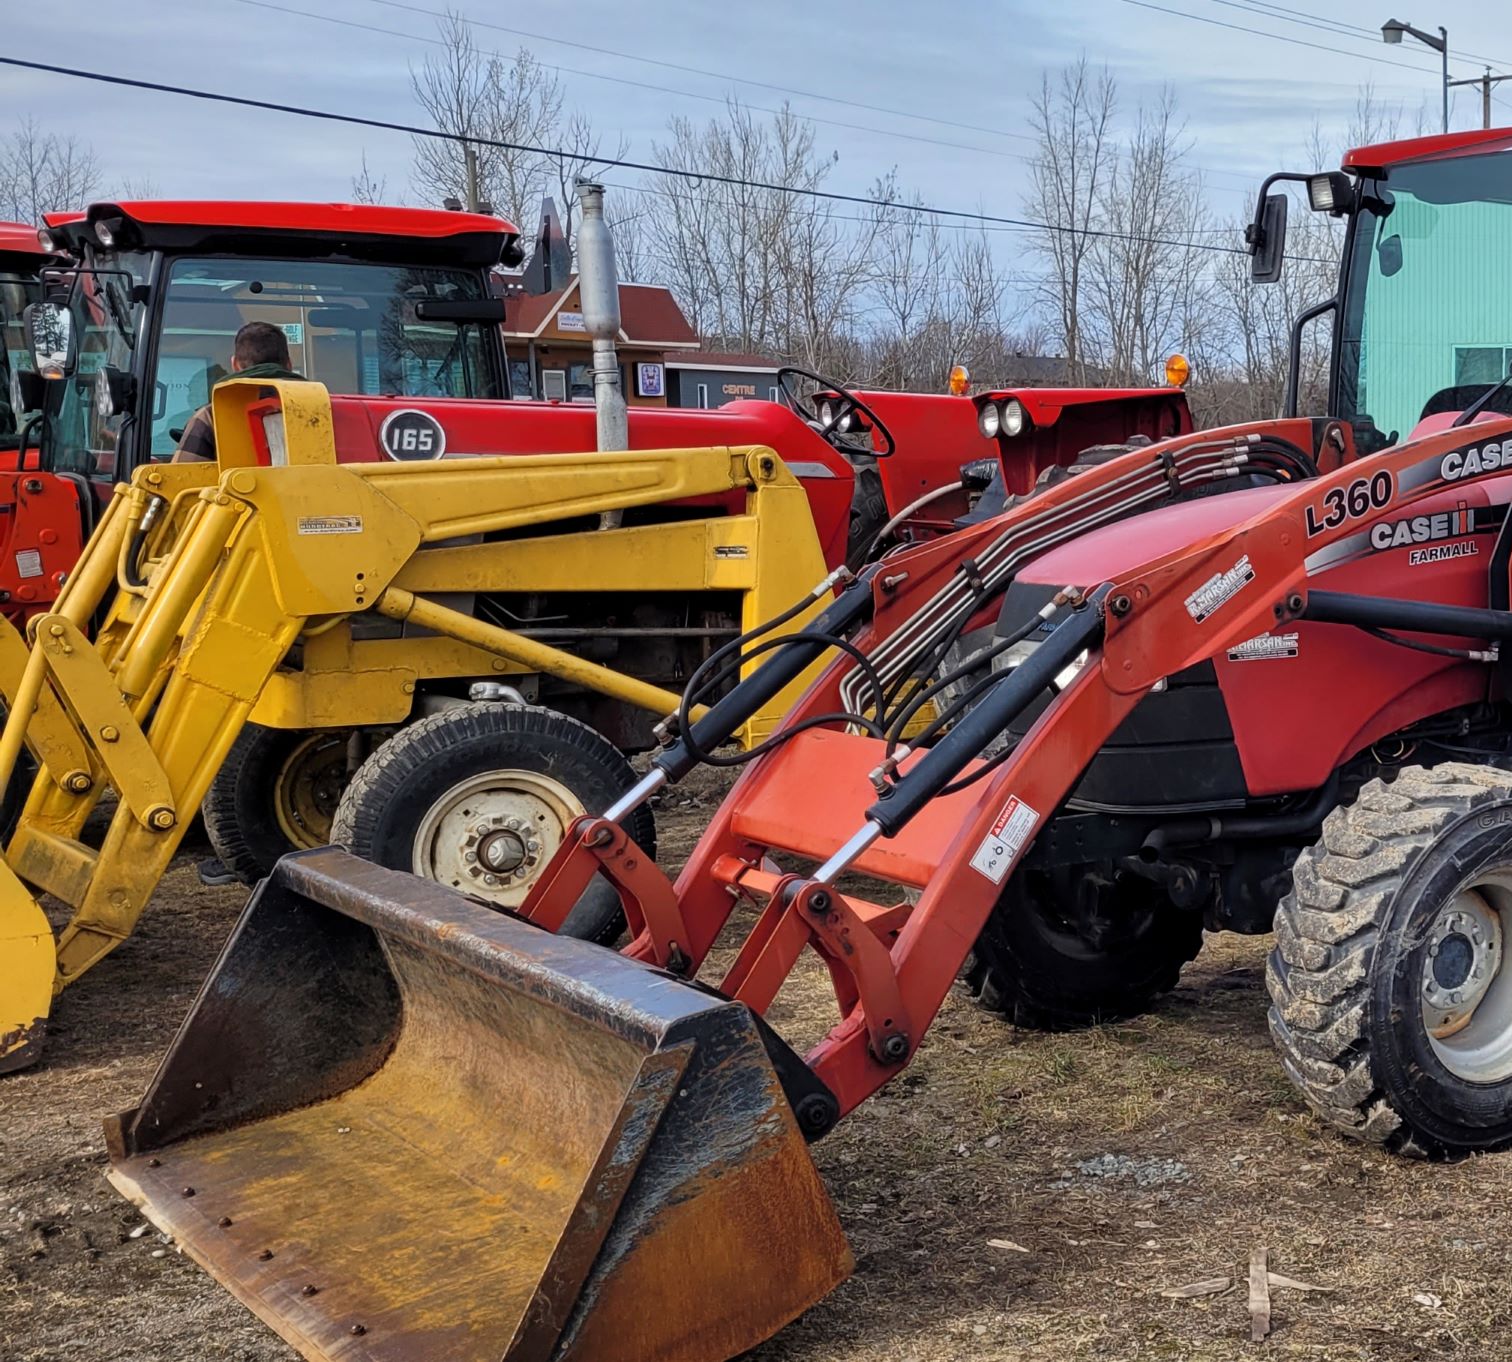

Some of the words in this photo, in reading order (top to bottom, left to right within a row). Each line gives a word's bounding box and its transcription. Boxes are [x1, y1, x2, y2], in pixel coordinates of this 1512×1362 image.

[722, 384, 756, 395] CENTRE
[392, 428, 434, 450] 165
[1305, 469, 1393, 538] L360
[1371, 514, 1449, 549] CASE
[1409, 541, 1478, 565] FARMALL
